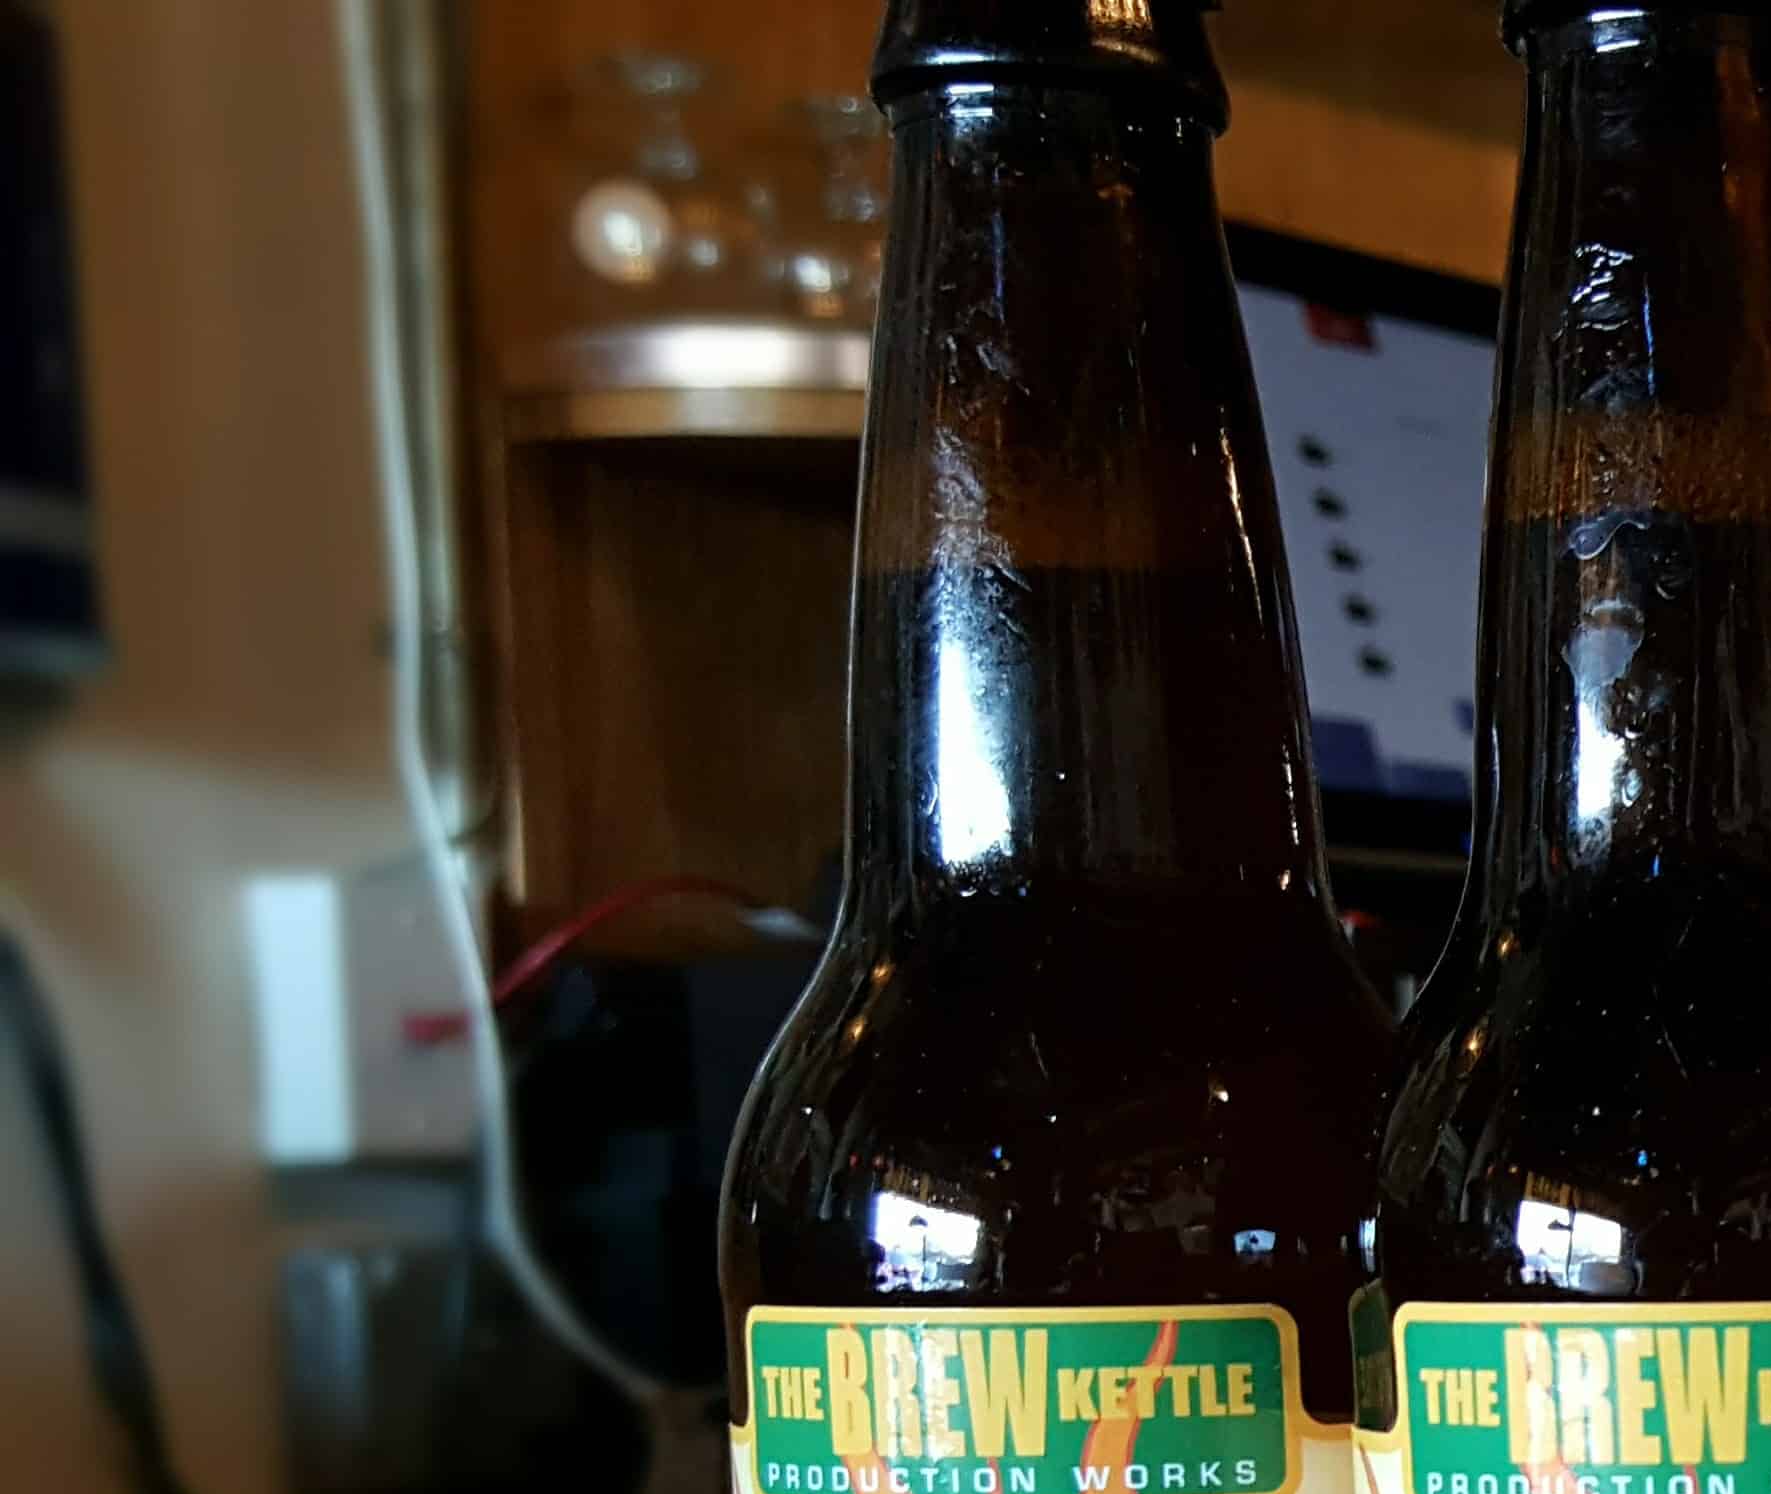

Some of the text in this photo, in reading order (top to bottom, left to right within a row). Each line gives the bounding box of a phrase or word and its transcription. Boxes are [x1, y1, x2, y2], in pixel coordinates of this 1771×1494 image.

[762, 1327, 1256, 1460] THE BREW KETTLE
[1420, 1367, 1500, 1427] THE
[1504, 1326, 1751, 1465] BREW
[767, 1459, 1257, 1494] PRODUCTION WORKS
